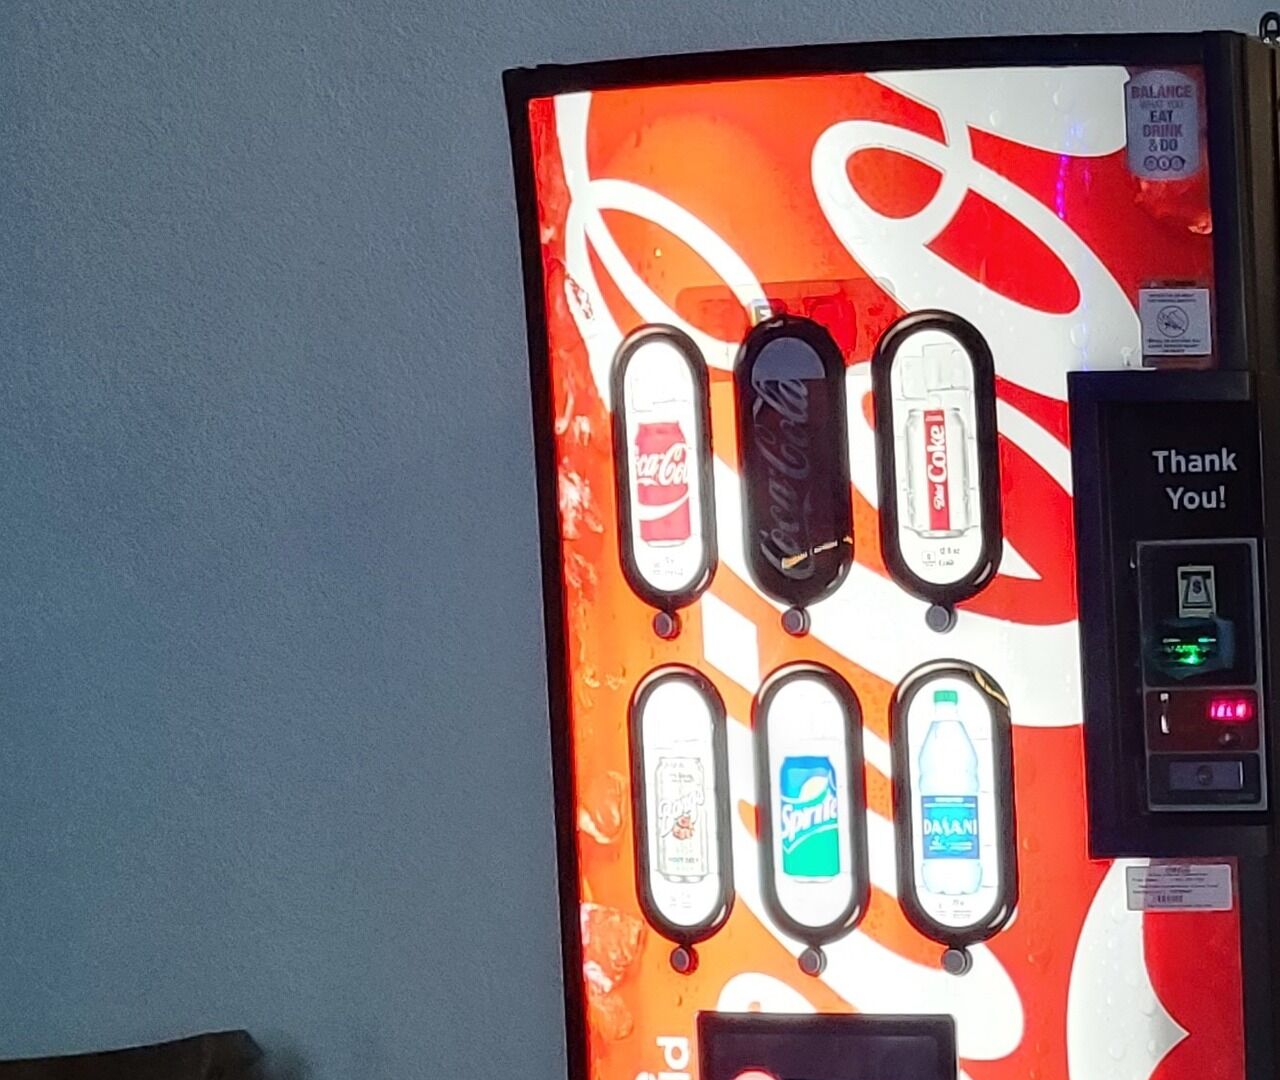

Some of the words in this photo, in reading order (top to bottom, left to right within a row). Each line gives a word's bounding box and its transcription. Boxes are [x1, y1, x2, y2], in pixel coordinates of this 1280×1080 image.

[1131, 85, 1193, 99] BALANCE
[1150, 110, 1173, 123] EAT
[1143, 124, 1183, 138] DRINK
[1160, 138, 1178, 152] DO
[926, 425, 948, 483] Coke
[1152, 447, 1238, 474] Thank
[1165, 485, 1227, 510] You!
[922, 815, 978, 837] DASANI
